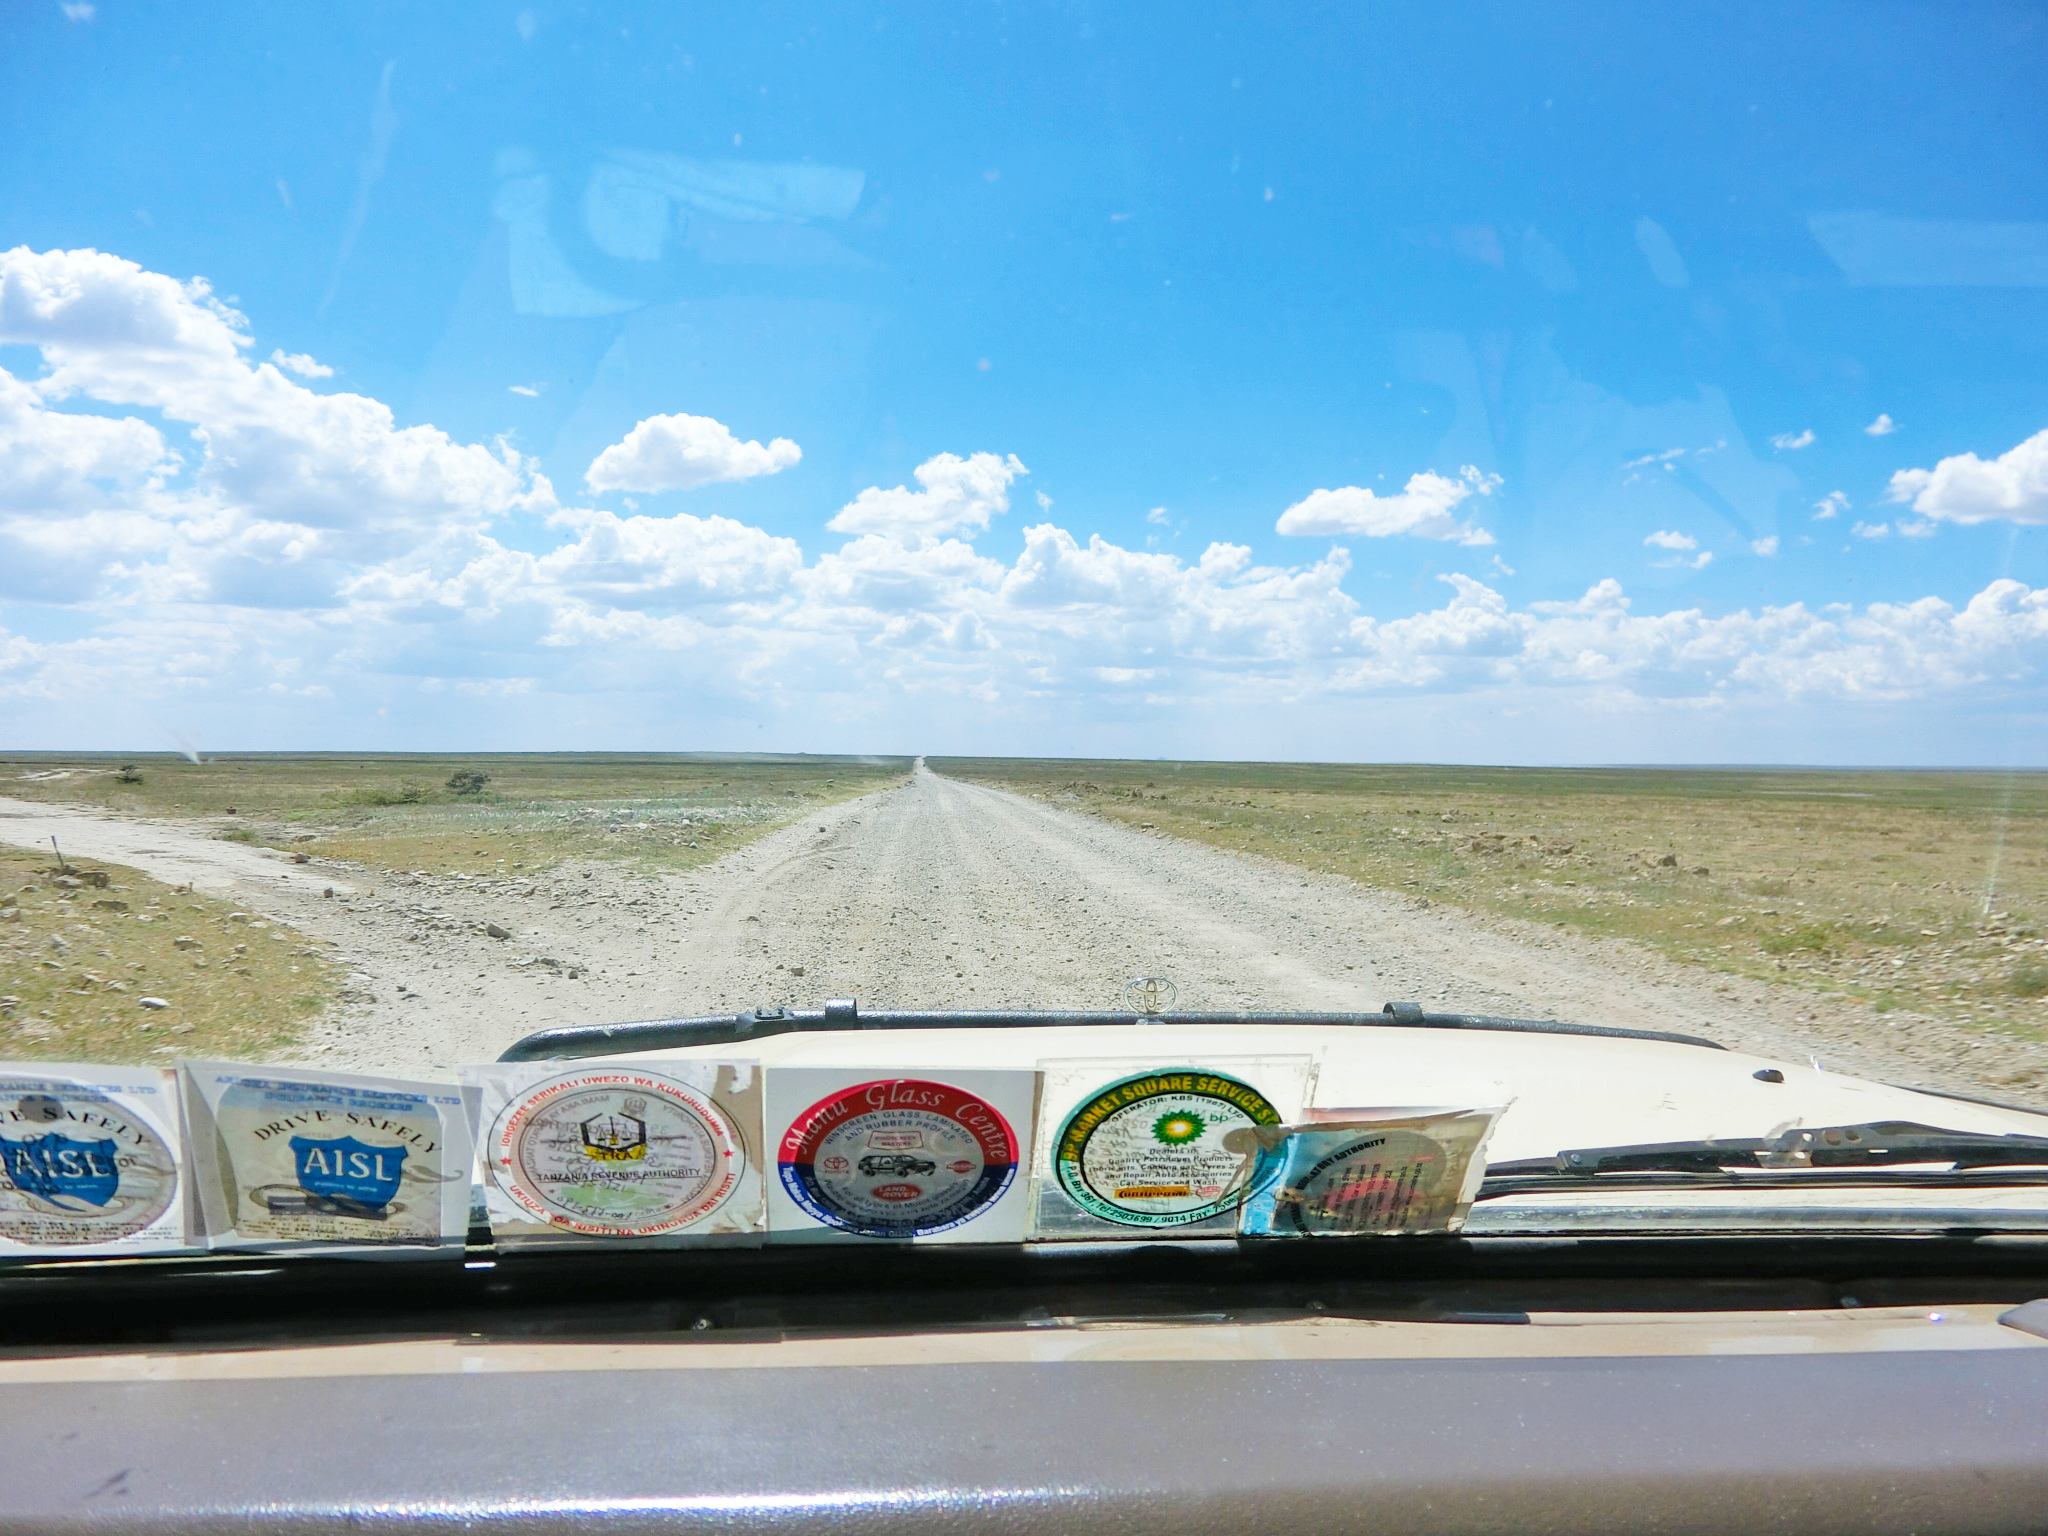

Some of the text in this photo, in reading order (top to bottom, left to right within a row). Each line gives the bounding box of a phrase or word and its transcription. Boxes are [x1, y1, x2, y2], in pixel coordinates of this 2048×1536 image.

[1121, 1076, 1193, 1100] SQUARE
[1196, 1077, 1264, 1112] SERVICE
[527, 1080, 579, 1106] SERIKALI
[581, 1076, 630, 1085] UWEZO
[634, 1077, 653, 1088] WA
[656, 1083, 724, 1136] KUKUHUDUMIA
[1070, 1093, 1120, 1142] MARKET
[1209, 1113, 1229, 1123] bp
[1227, 1107, 1244, 1119] LTD
[43, 1106, 151, 1145] SAFELY
[253, 1109, 442, 1153] DRIVE SAFELY
[786, 1080, 1007, 1158] Manu Glass Centre
[824, 1113, 878, 1145] WINSCREEN
[845, 1120, 956, 1141] AND RUBBER PROFILE
[598, 1151, 632, 1160] TRA
[1063, 1143, 1078, 1161] BP
[1108, 1157, 1140, 1165] Quality
[1334, 1137, 1386, 1161] AUTHORITY
[15, 1148, 110, 1178] AISL
[304, 1148, 393, 1181] AISL
[536, 1168, 702, 1181] TANZANIA REVENUE AUTHORITY
[509, 1185, 546, 1214] UKIUZA
[573, 1221, 612, 1236] RISITI
[700, 1198, 719, 1212] DAI
[715, 1173, 736, 1199] RISITI
[882, 1190, 919, 1198] ROVER
[916, 1222, 956, 1236] Barabara
[955, 1217, 966, 1226] ya
[1161, 1215, 1187, 1223] 9014
